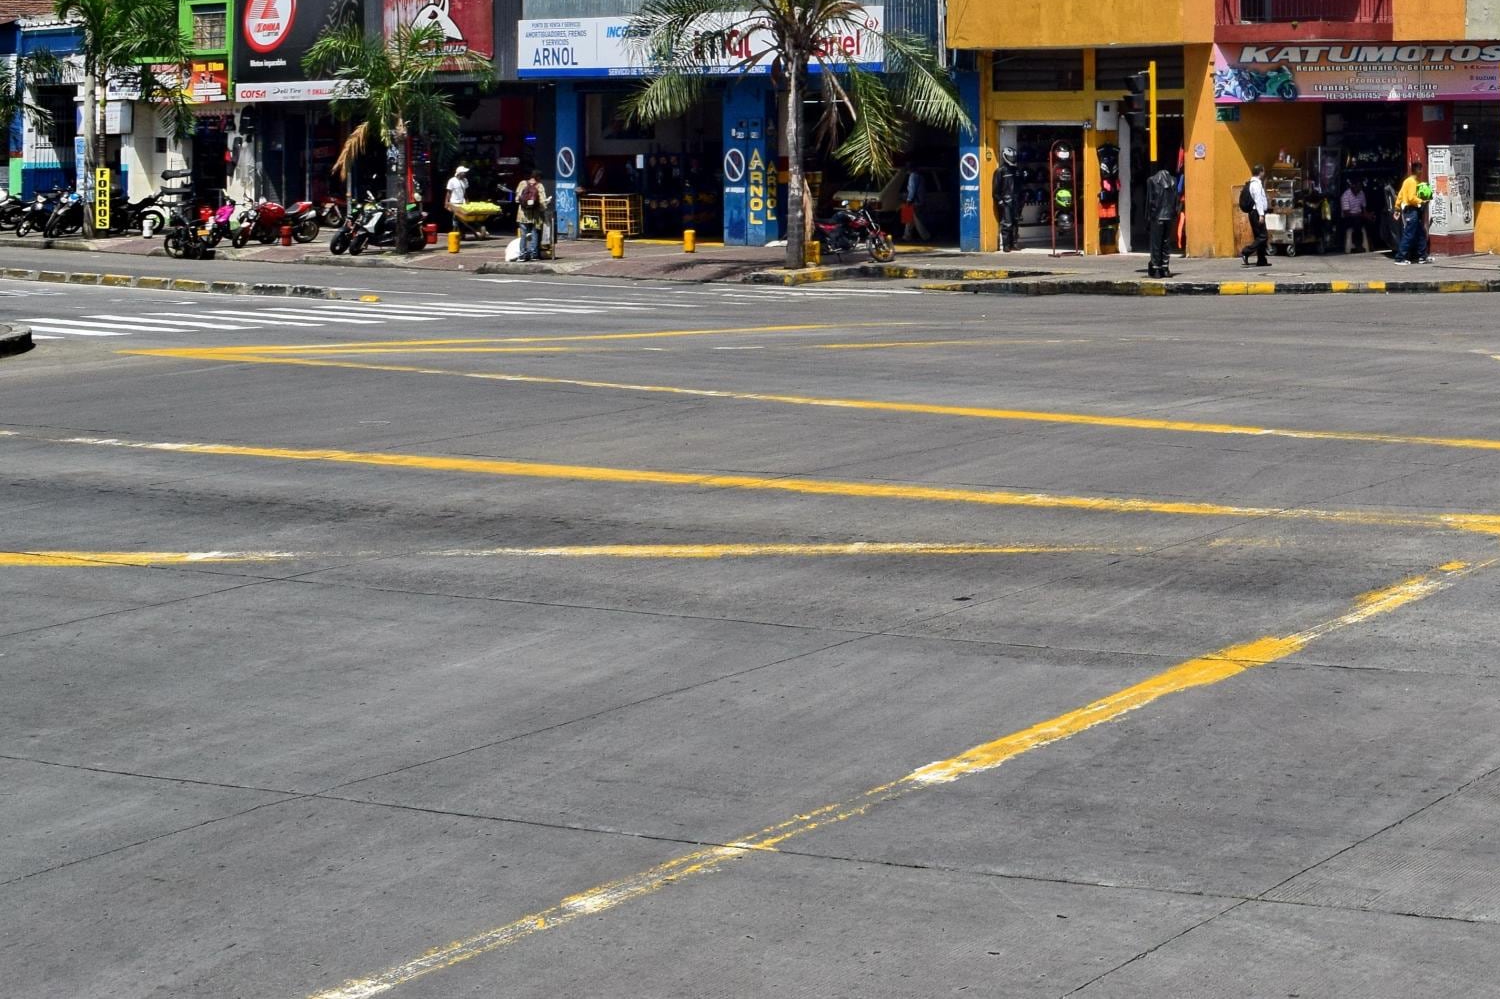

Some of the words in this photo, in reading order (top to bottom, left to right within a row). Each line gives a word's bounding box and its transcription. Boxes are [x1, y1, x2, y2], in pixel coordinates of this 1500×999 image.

[532, 47, 579, 66] ARNOL
[1348, 64, 1398, 72] Originales
[98, 169, 108, 228] FORROS
[748, 147, 766, 226] ARNOL
